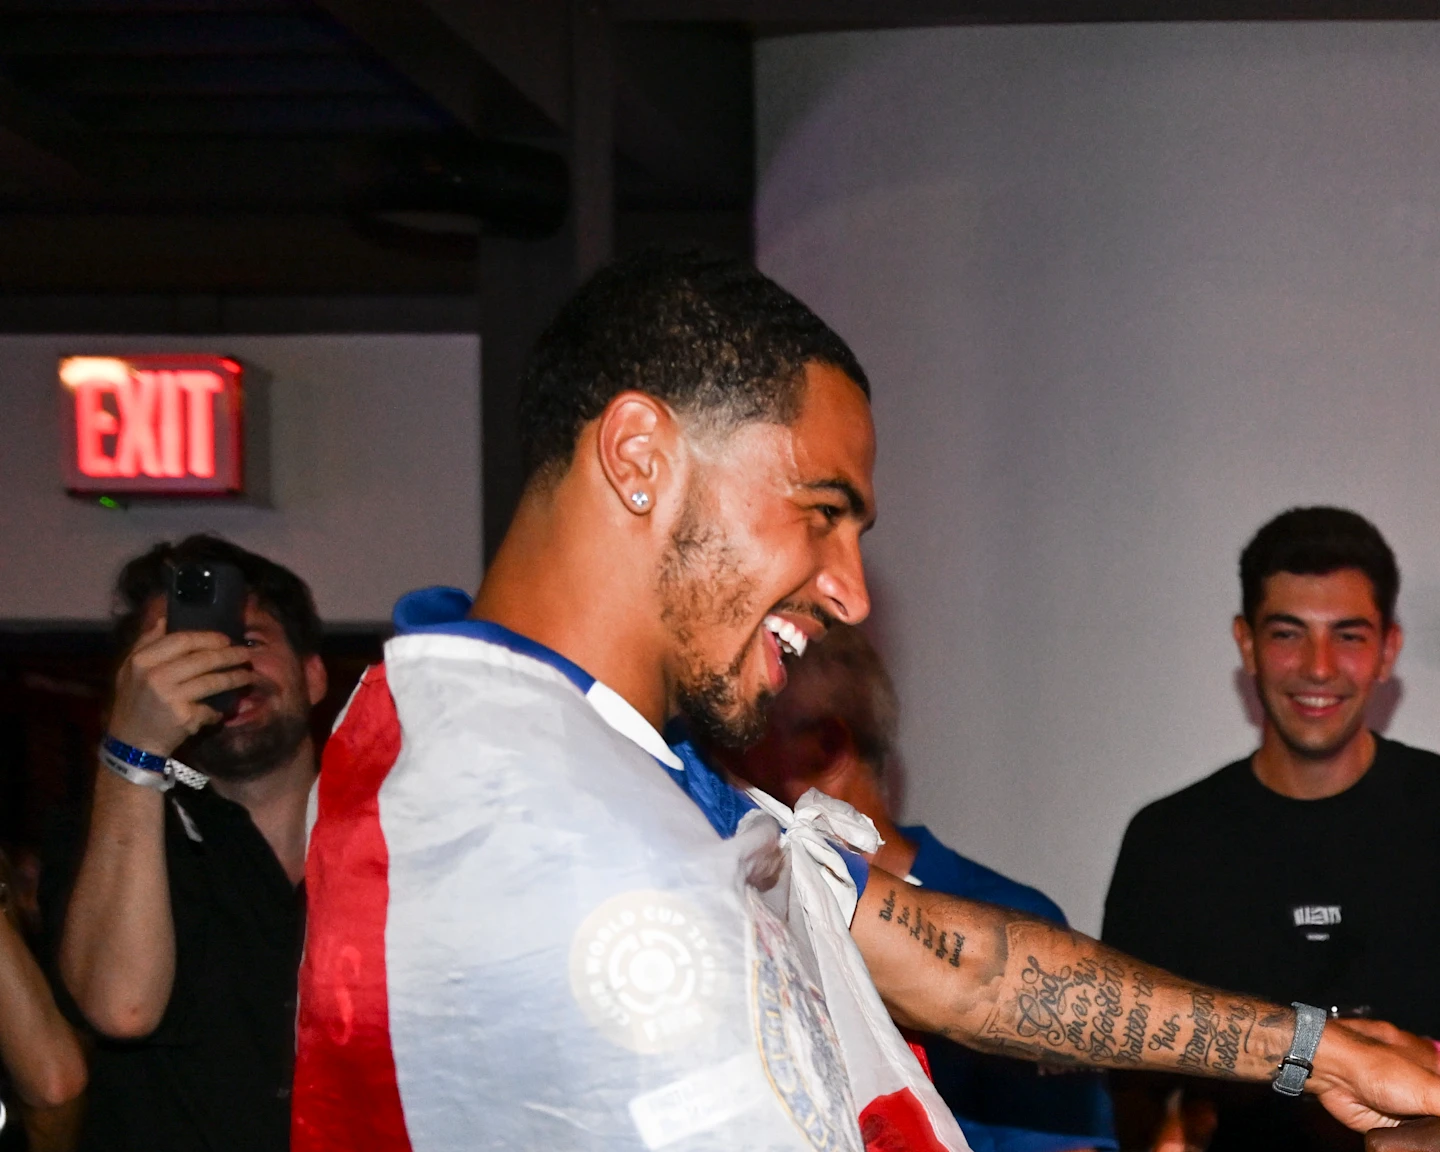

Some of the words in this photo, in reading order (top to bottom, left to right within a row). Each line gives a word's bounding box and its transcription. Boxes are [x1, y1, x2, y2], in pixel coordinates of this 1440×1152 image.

[73, 368, 225, 478] EXIT
[586, 910, 637, 975] WORLD
[642, 905, 686, 925] CUP
[1017, 955, 1071, 1047] God
[1066, 988, 1092, 1051] gives
[1148, 1013, 1180, 1051] his
